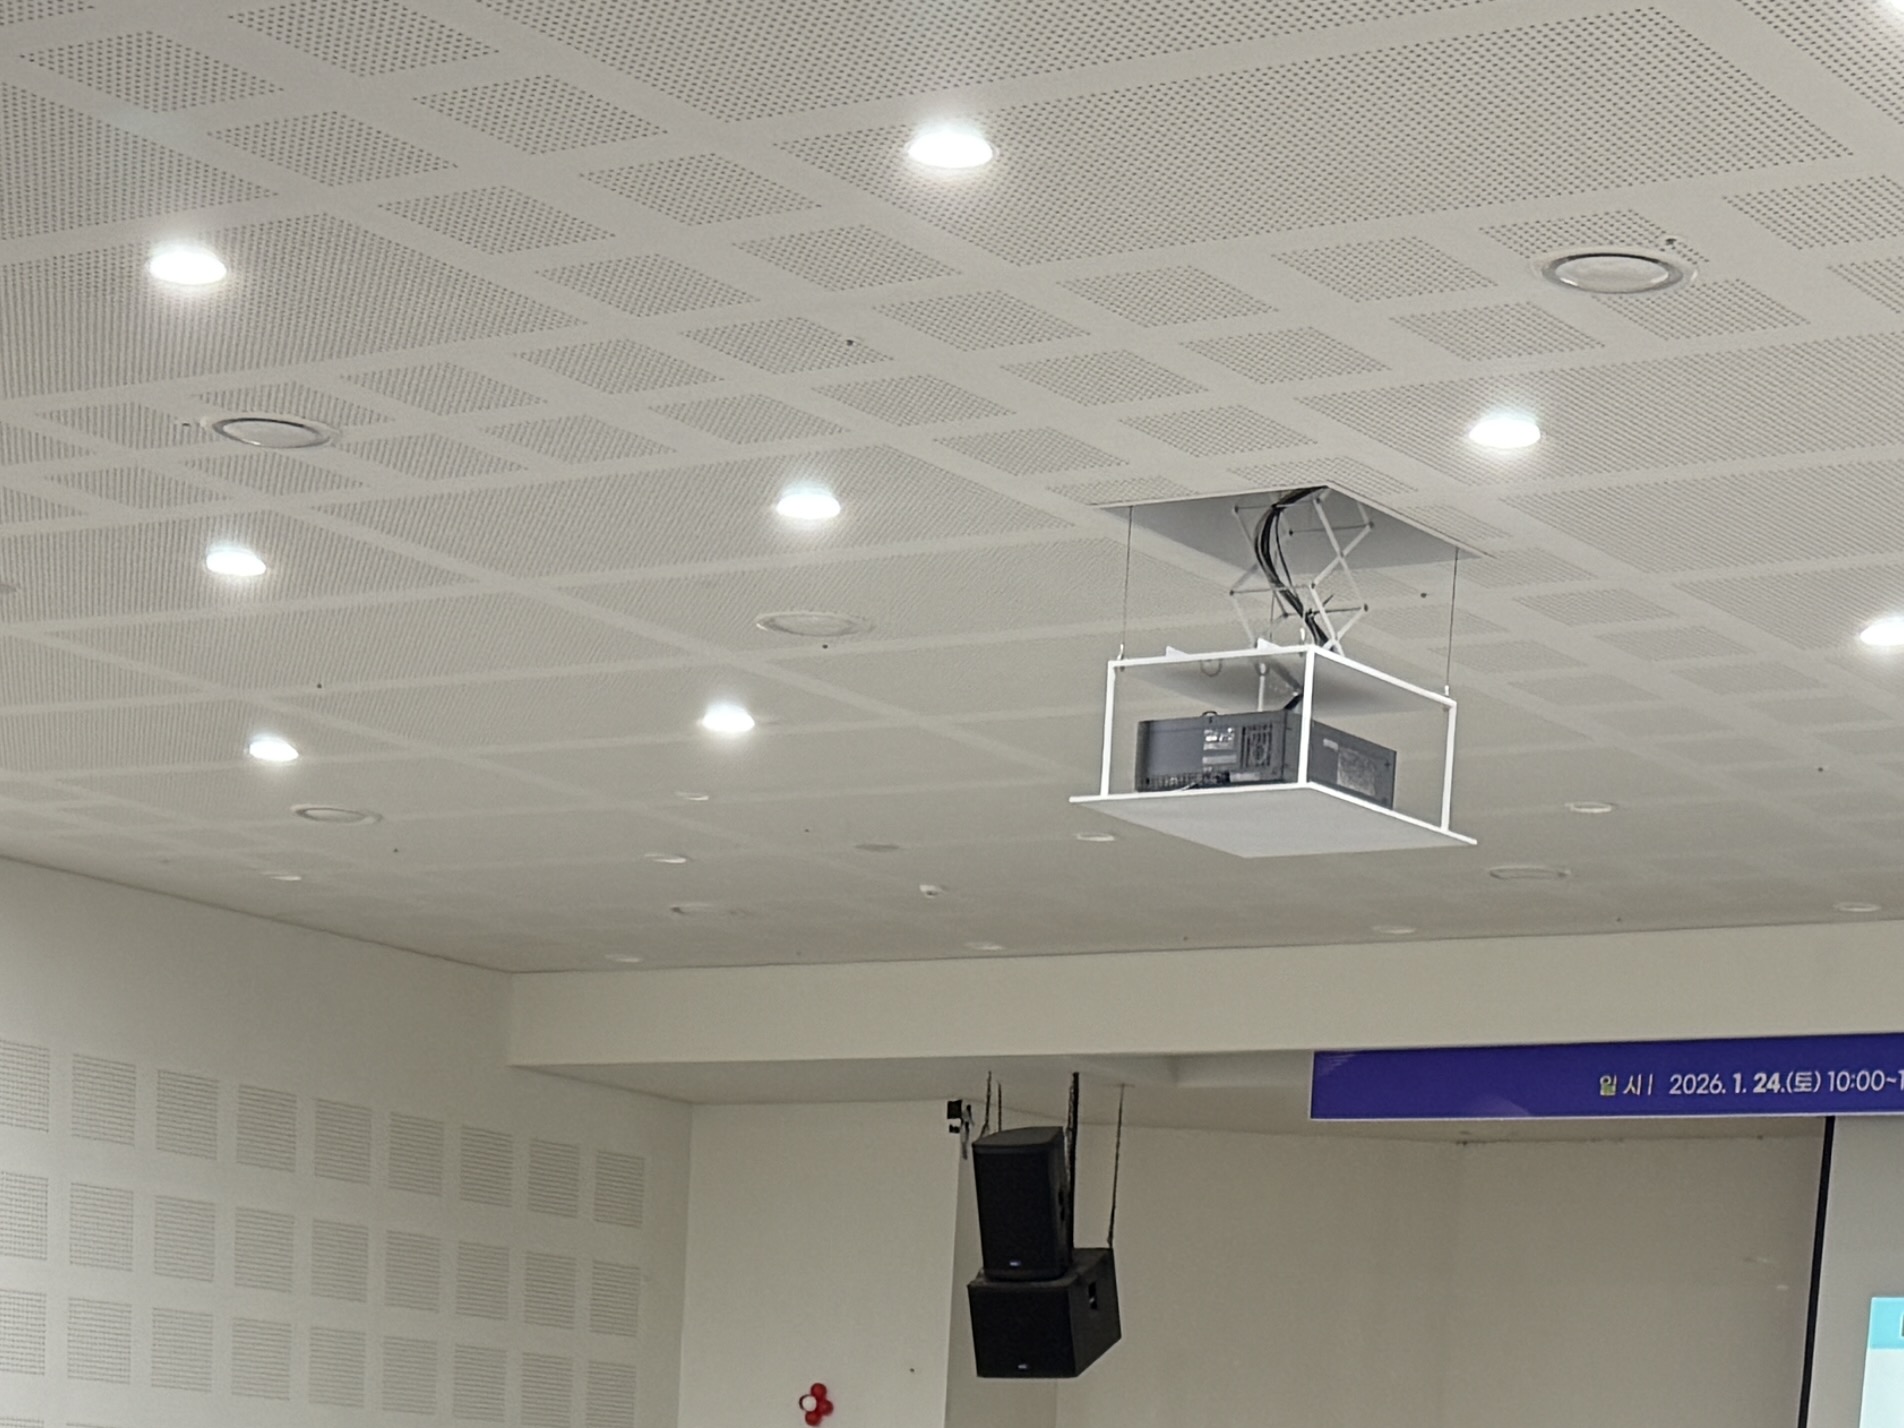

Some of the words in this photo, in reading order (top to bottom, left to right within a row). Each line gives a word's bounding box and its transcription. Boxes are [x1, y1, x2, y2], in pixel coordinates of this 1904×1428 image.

[1668, 1072, 1727, 1095] 2026.
[1732, 1072, 1747, 1095] 1.
[1752, 1070, 1822, 1094] 24.(토)
